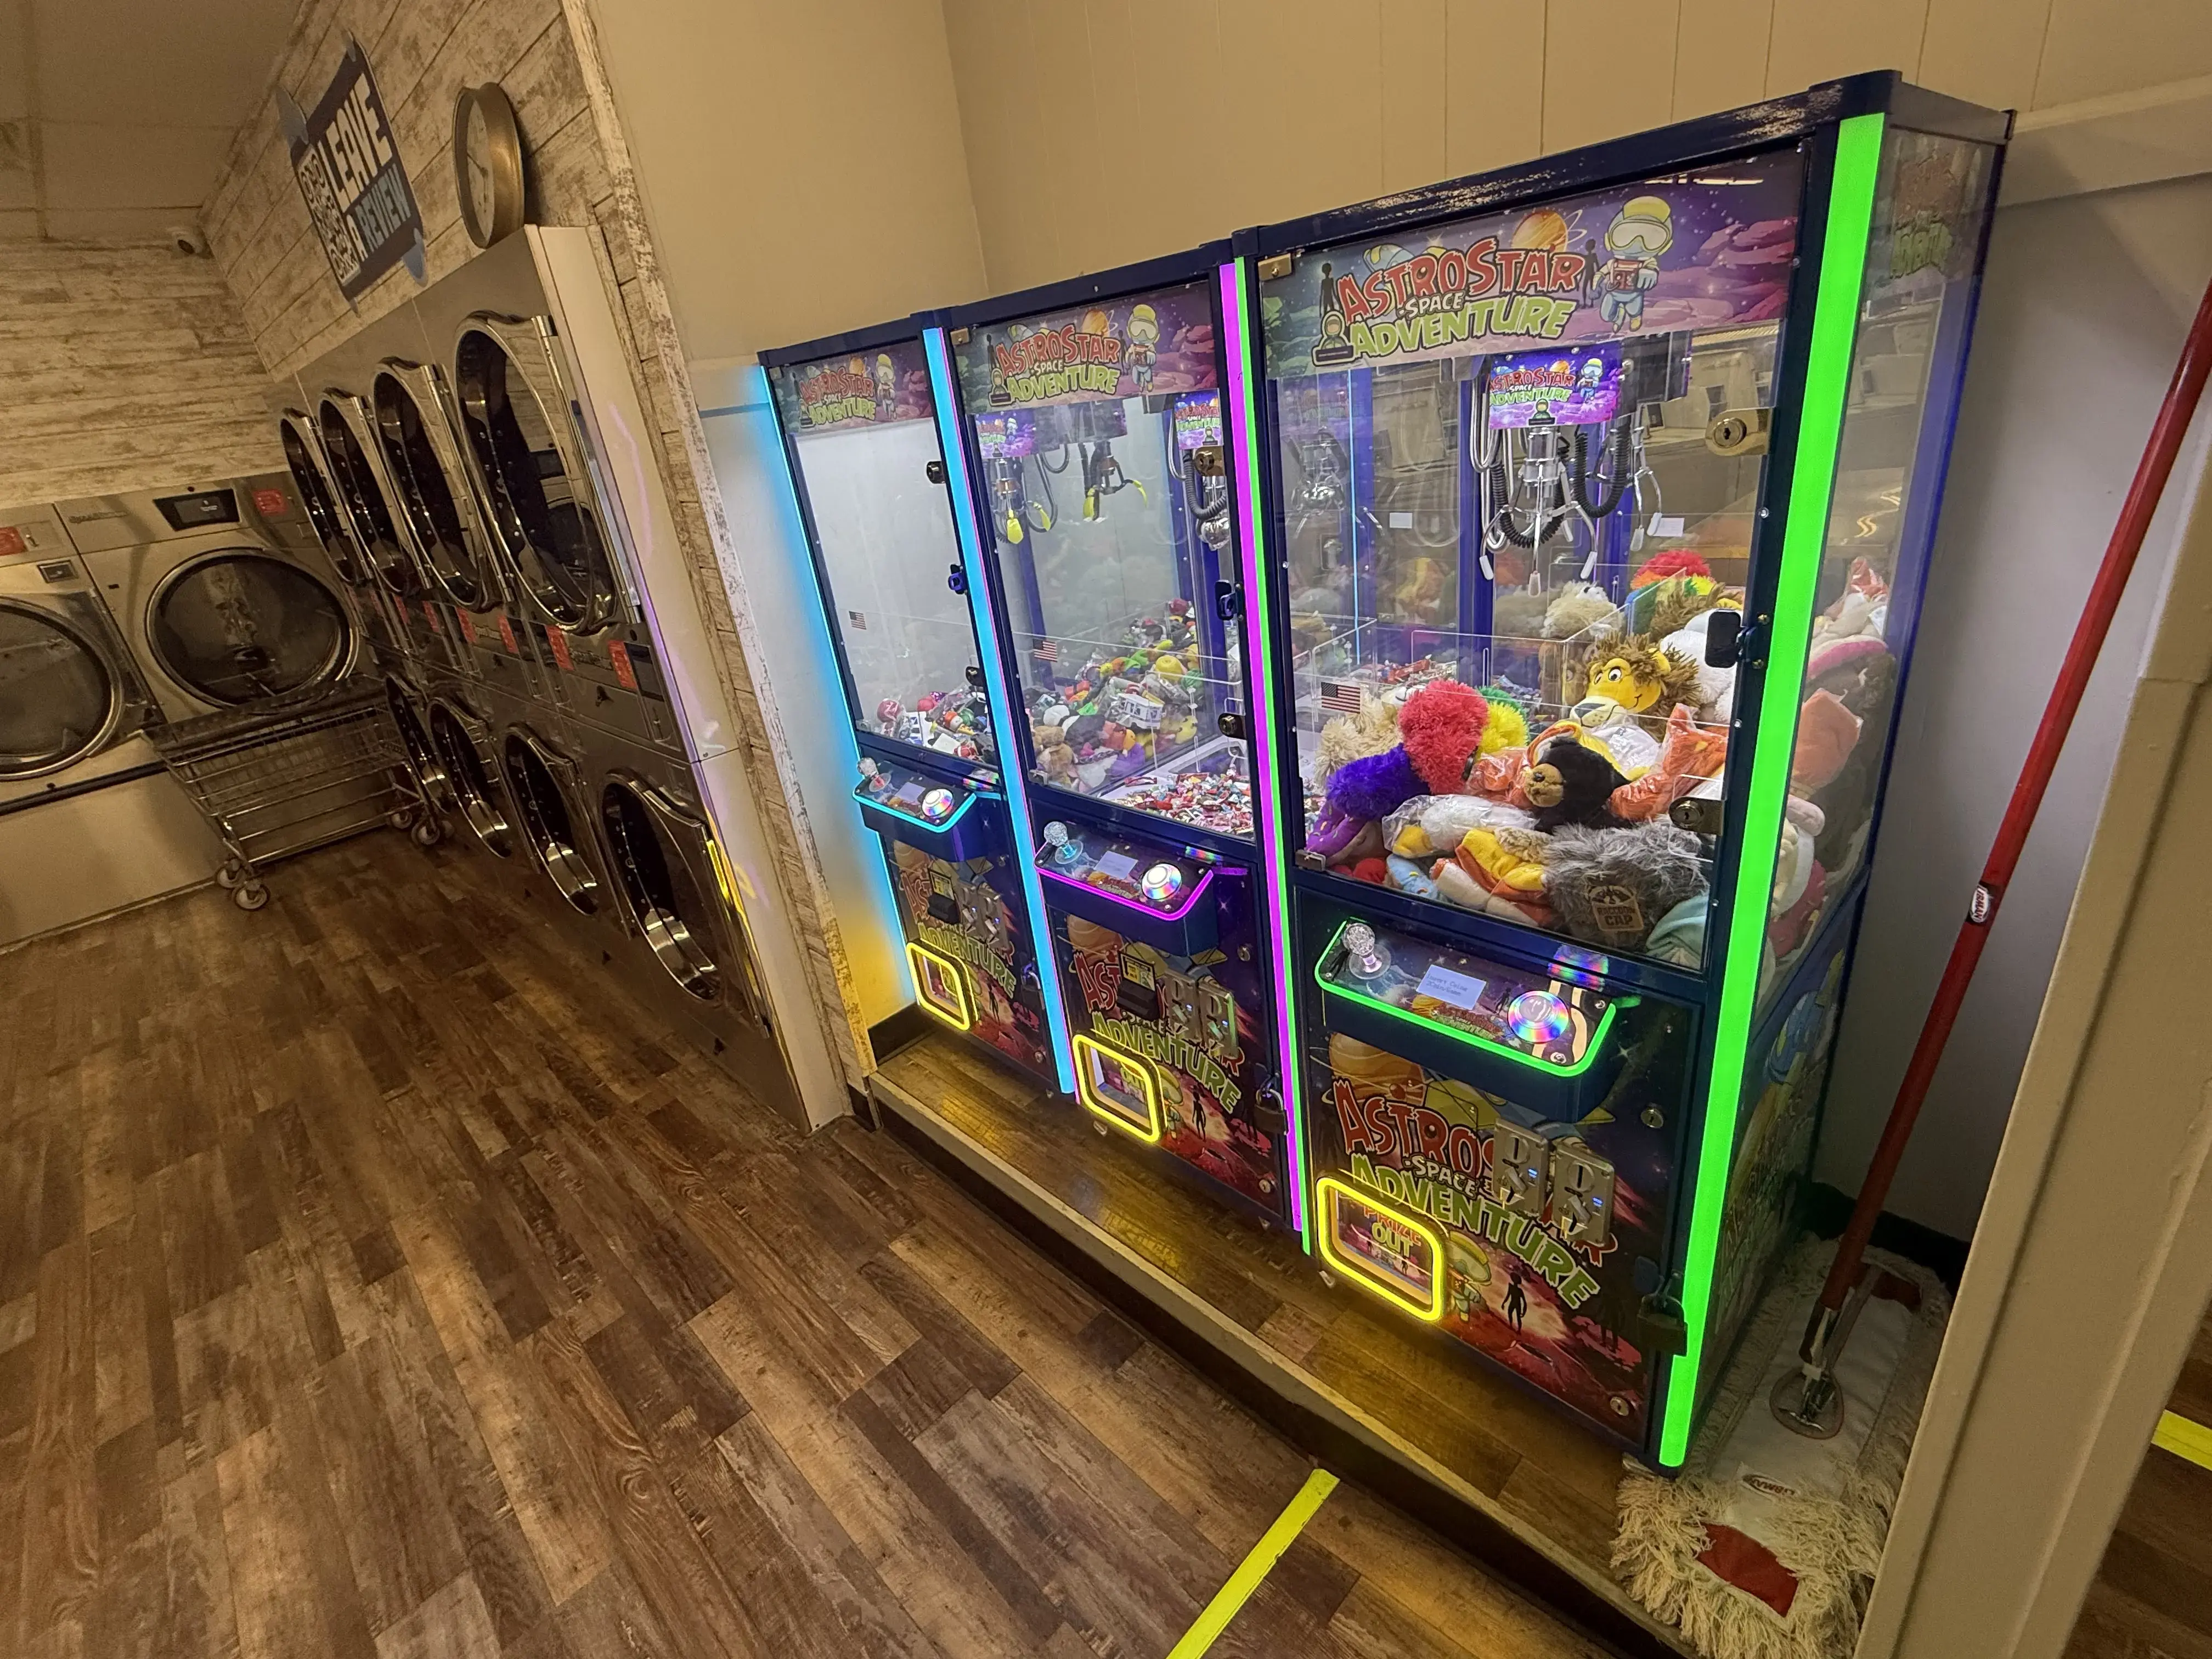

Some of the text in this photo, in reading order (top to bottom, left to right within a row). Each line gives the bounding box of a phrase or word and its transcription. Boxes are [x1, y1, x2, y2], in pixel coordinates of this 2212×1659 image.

[317, 72, 393, 213] LEAVE
[346, 163, 411, 262] A REVIEW
[1336, 236, 1585, 325] ASTROSTAR
[1350, 296, 1577, 357] ADVENTURE
[1404, 291, 1466, 319] SPACE
[995, 324, 1121, 377] ASTROSTAR
[1033, 360, 1064, 375] SPACE
[799, 366, 874, 405] ASTROSTAR
[1006, 363, 1120, 401] ADVENTURE
[808, 396, 876, 425] ADVENTURE
[1604, 915, 1633, 926] CAP
[917, 922, 1017, 1000] ADVENTURE
[1091, 1011, 1242, 1114] ADVENTURE
[1410, 1155, 1477, 1195] SPACE
[1351, 1152, 1601, 1310] ADVENTURE
[1372, 1222, 1414, 1257] OUT
